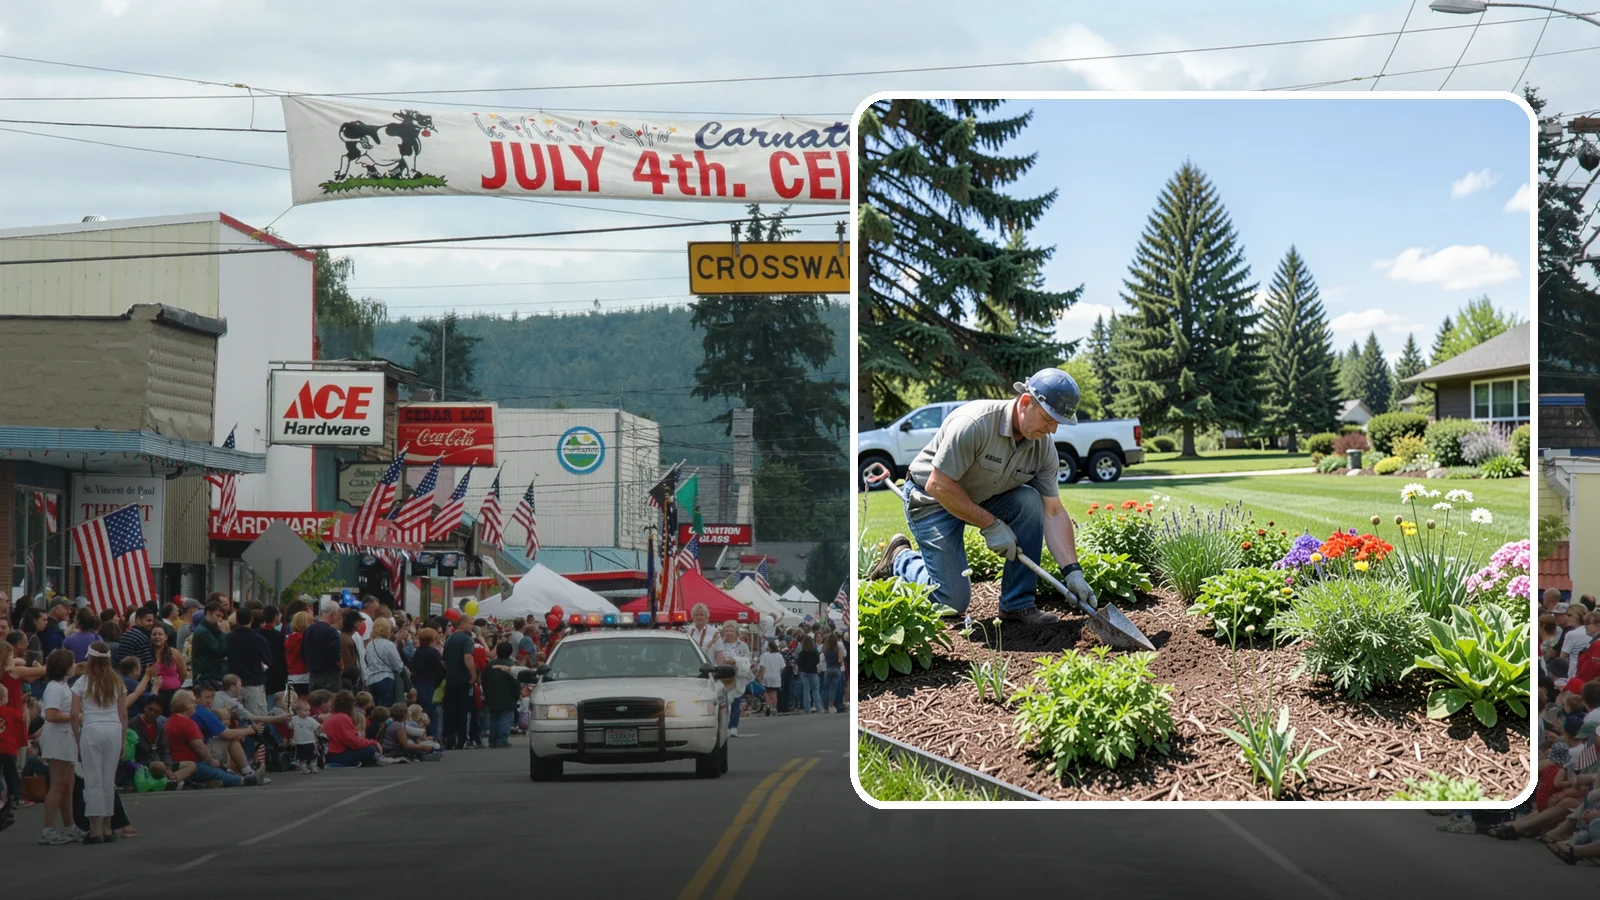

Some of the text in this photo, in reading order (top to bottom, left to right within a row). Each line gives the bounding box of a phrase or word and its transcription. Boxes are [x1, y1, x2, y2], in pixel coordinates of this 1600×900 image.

[481, 141, 605, 192] JULY
[632, 150, 746, 197] 4th.
[697, 253, 850, 280] CROSSWA
[283, 380, 373, 420] ACE
[406, 410, 452, 422] CEDAR
[284, 421, 370, 436] Hardware
[96, 485, 124, 495] Vincent
[126, 485, 136, 495] de
[138, 486, 155, 495] Paul
[688, 526, 741, 535] CRNATION
[699, 535, 730, 543] GLASS
